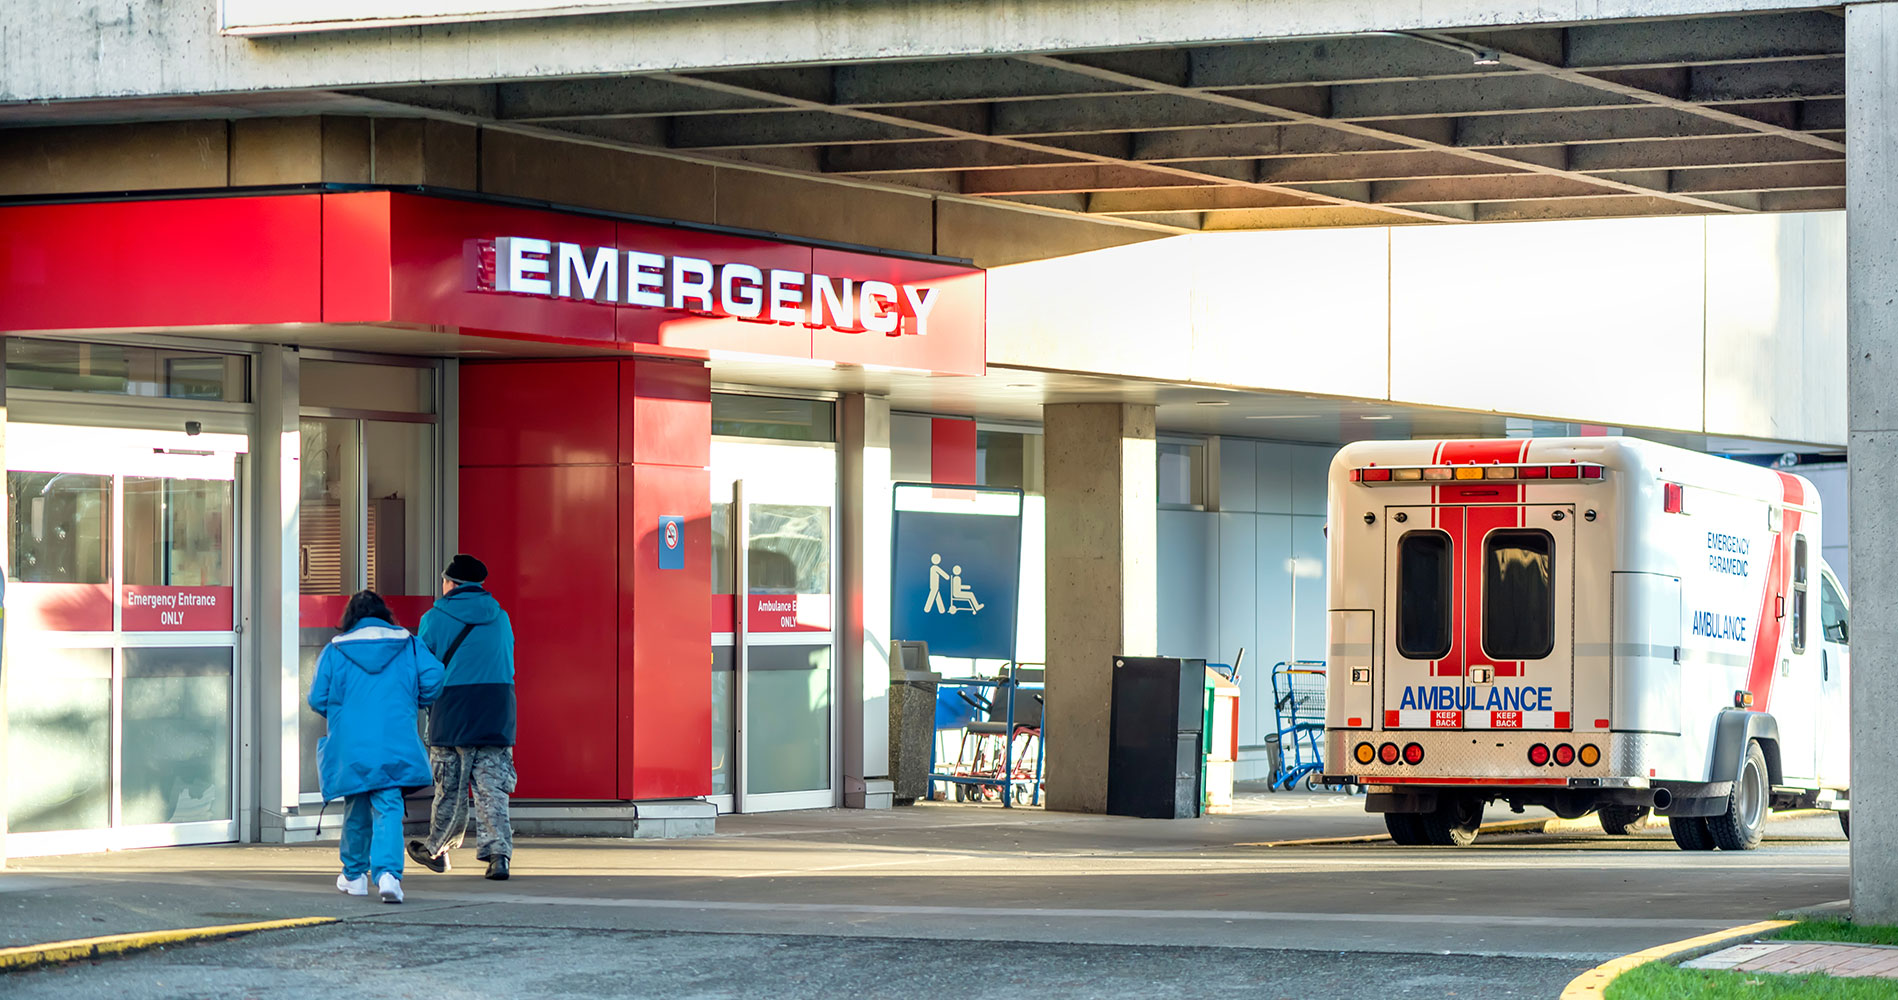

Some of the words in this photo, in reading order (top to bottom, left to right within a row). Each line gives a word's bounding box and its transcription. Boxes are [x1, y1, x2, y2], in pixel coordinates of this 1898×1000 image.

[496, 236, 941, 335] EMERGENCY
[1707, 531, 1750, 556] EMERGENCY
[1709, 554, 1749, 577] PARAMEDIC
[128, 592, 177, 609] Emergency
[178, 592, 216, 606] Entrance
[758, 600, 791, 612] Ambulance
[161, 611, 184, 625] ONLY
[780, 616, 797, 628] ONLY
[1692, 610, 1747, 642] AMBULANCE
[1400, 686, 1553, 711] AMBULANCE
[1436, 719, 1457, 727] BACK
